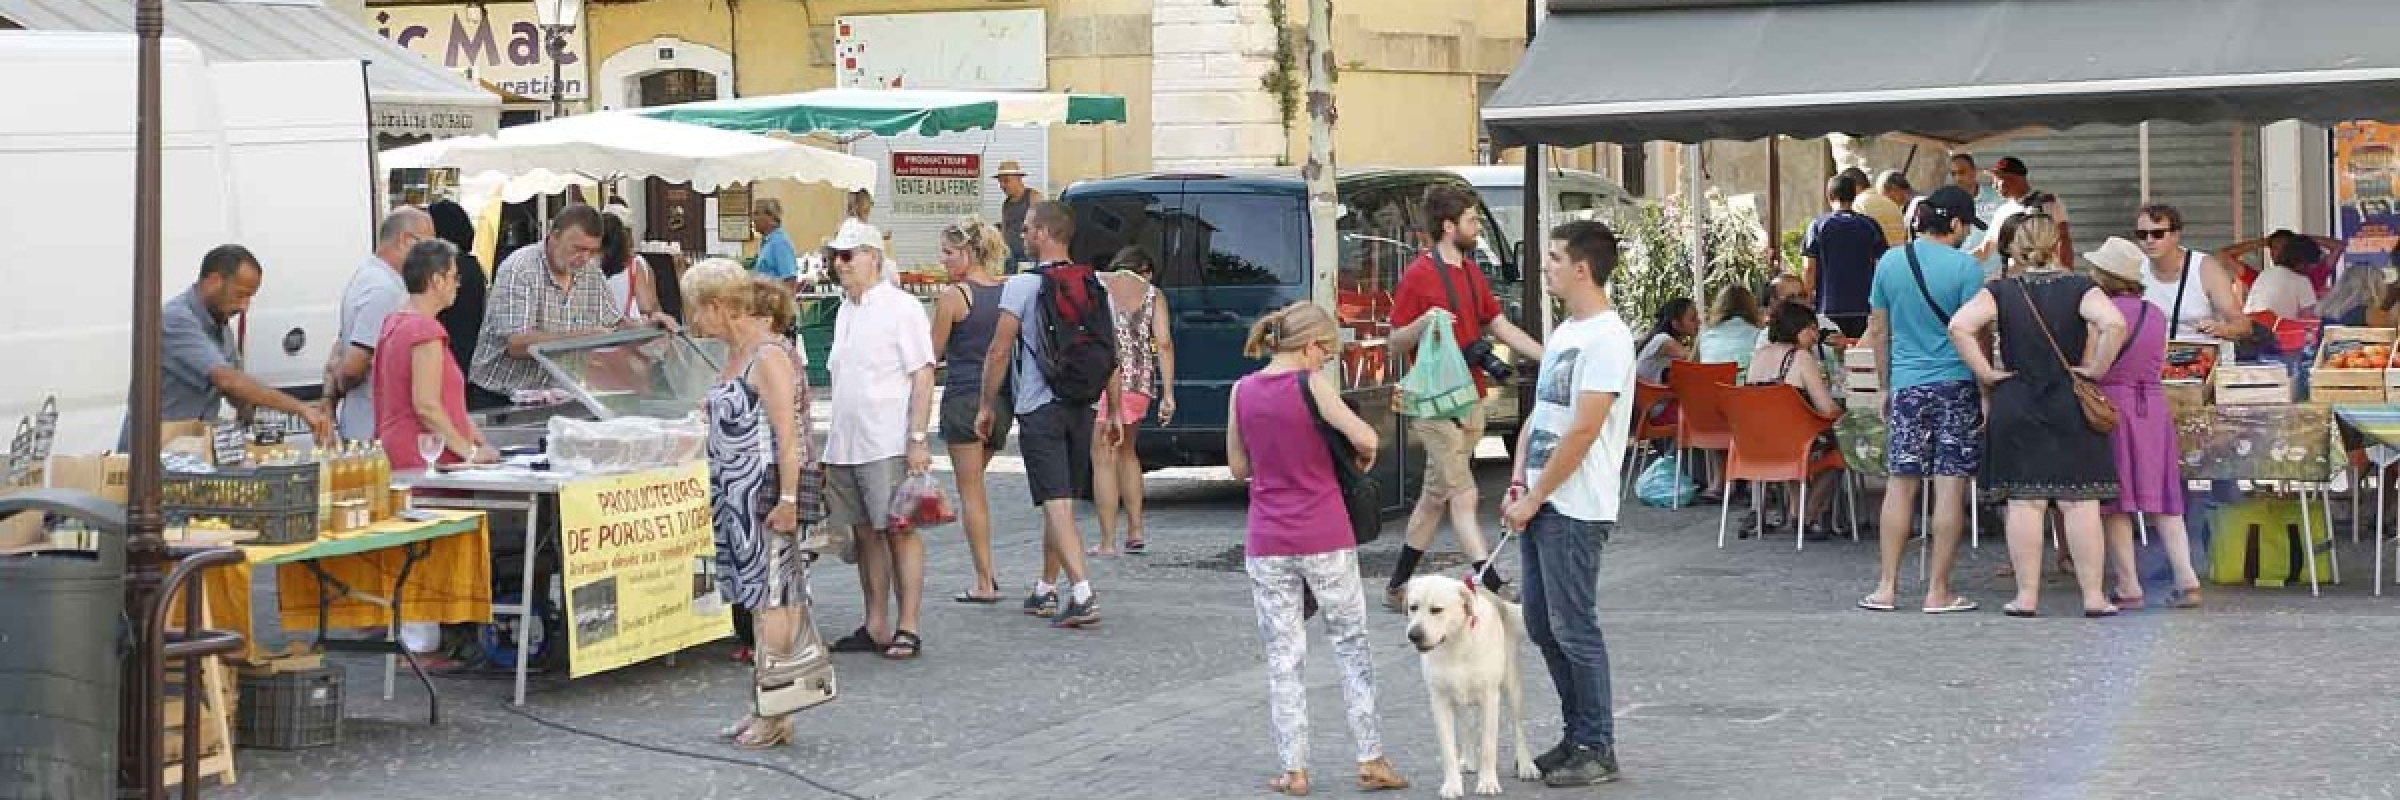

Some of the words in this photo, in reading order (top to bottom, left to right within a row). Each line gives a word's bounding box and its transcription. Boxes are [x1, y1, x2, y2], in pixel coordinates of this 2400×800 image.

[444, 11, 579, 67] Mac
[895, 177, 924, 195] VENTE
[933, 179, 947, 195] LA
[947, 179, 979, 197] FERME
[597, 477, 704, 516] PRODUCTEURS
[567, 526, 592, 555] DE
[598, 516, 655, 550] PORCS
[654, 513, 676, 539] ET
